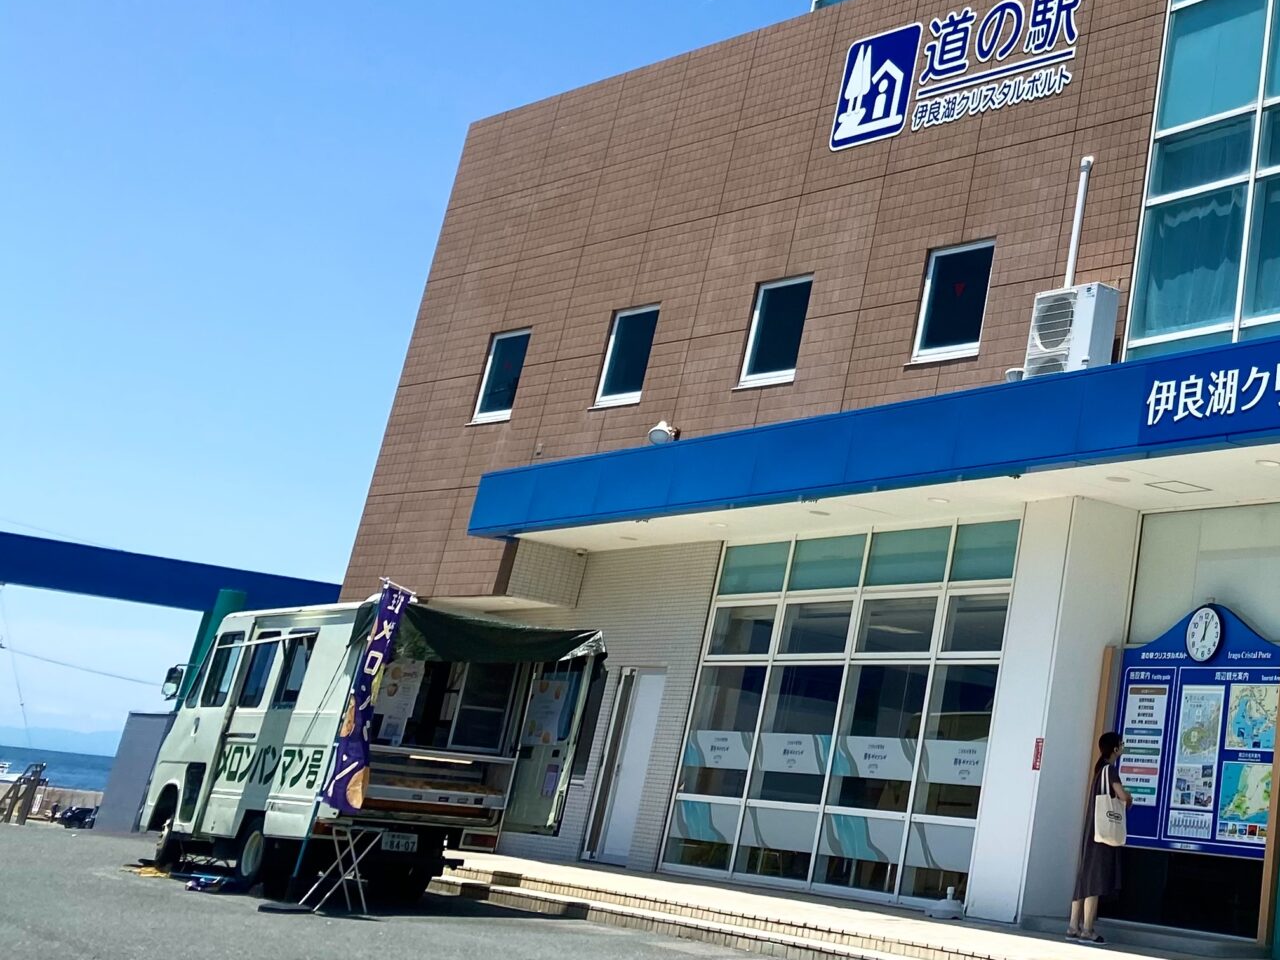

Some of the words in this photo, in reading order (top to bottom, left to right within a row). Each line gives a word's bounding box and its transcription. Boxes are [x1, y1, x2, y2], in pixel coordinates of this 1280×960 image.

[912, 66, 1072, 131] 伊良湖クリスタルポルト
